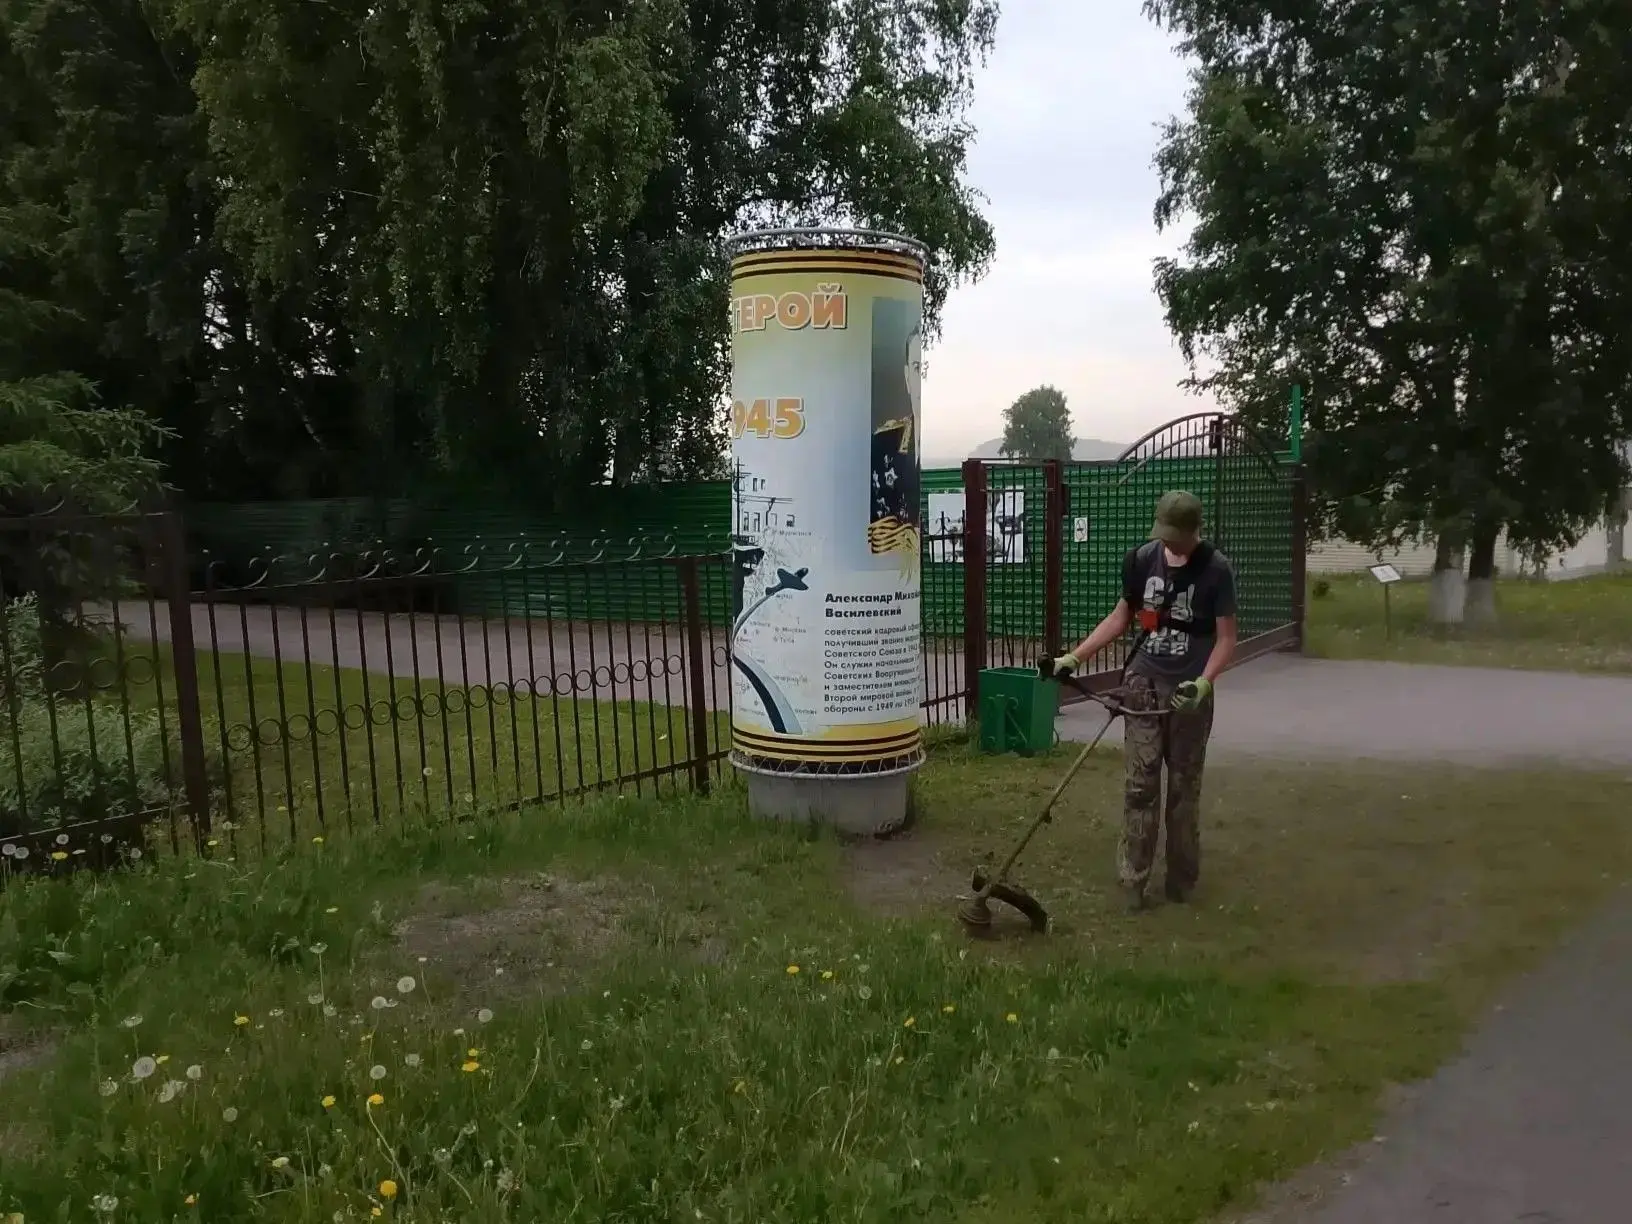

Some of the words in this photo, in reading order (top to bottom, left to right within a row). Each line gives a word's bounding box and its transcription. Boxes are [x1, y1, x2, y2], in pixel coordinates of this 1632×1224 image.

[732, 283, 847, 332] ГЕРОЙ
[825, 593, 893, 605] Александр
[825, 606, 902, 618] Василевский
[824, 627, 872, 636] советский
[874, 624, 907, 635] кадровый
[824, 639, 879, 648] получивший
[824, 649, 877, 658] Советского
[824, 660, 838, 669] Он
[841, 661, 873, 670] служил
[824, 671, 872, 680] Советских
[833, 681, 893, 691] заместителем
[824, 693, 858, 703] Второй
[860, 691, 894, 702] мировой
[824, 704, 866, 714] обороны
[876, 702, 894, 711] 1949
